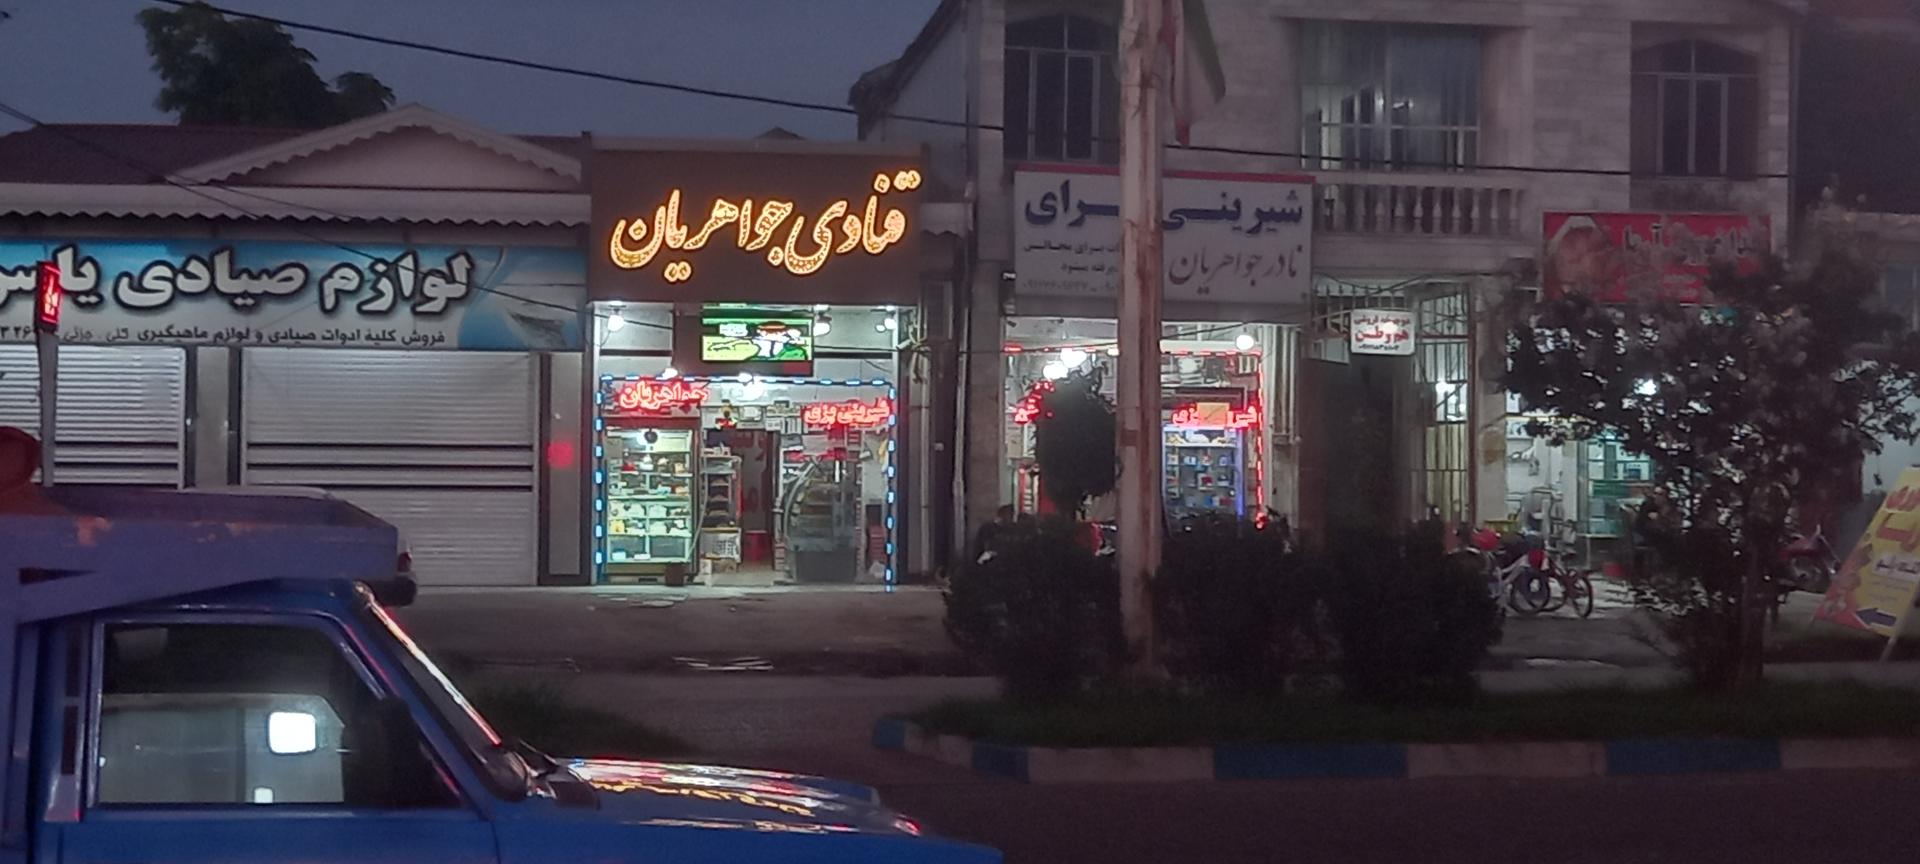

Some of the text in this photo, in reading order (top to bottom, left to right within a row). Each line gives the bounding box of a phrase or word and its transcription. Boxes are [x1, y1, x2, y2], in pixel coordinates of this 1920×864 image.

[1025, 179, 1304, 234] شیرینی رای
[609, 168, 919, 283] قنادی جواهریان
[114, 247, 309, 310] صیادی
[317, 250, 472, 313] لوازم
[1168, 244, 1303, 295] نادر جواهریان
[136, 324, 209, 342] ماهیگیری
[212, 327, 251, 344] لوازم
[267, 328, 317, 345] صیادی
[321, 328, 361, 346] ادوات
[401, 328, 446, 346] فروش
